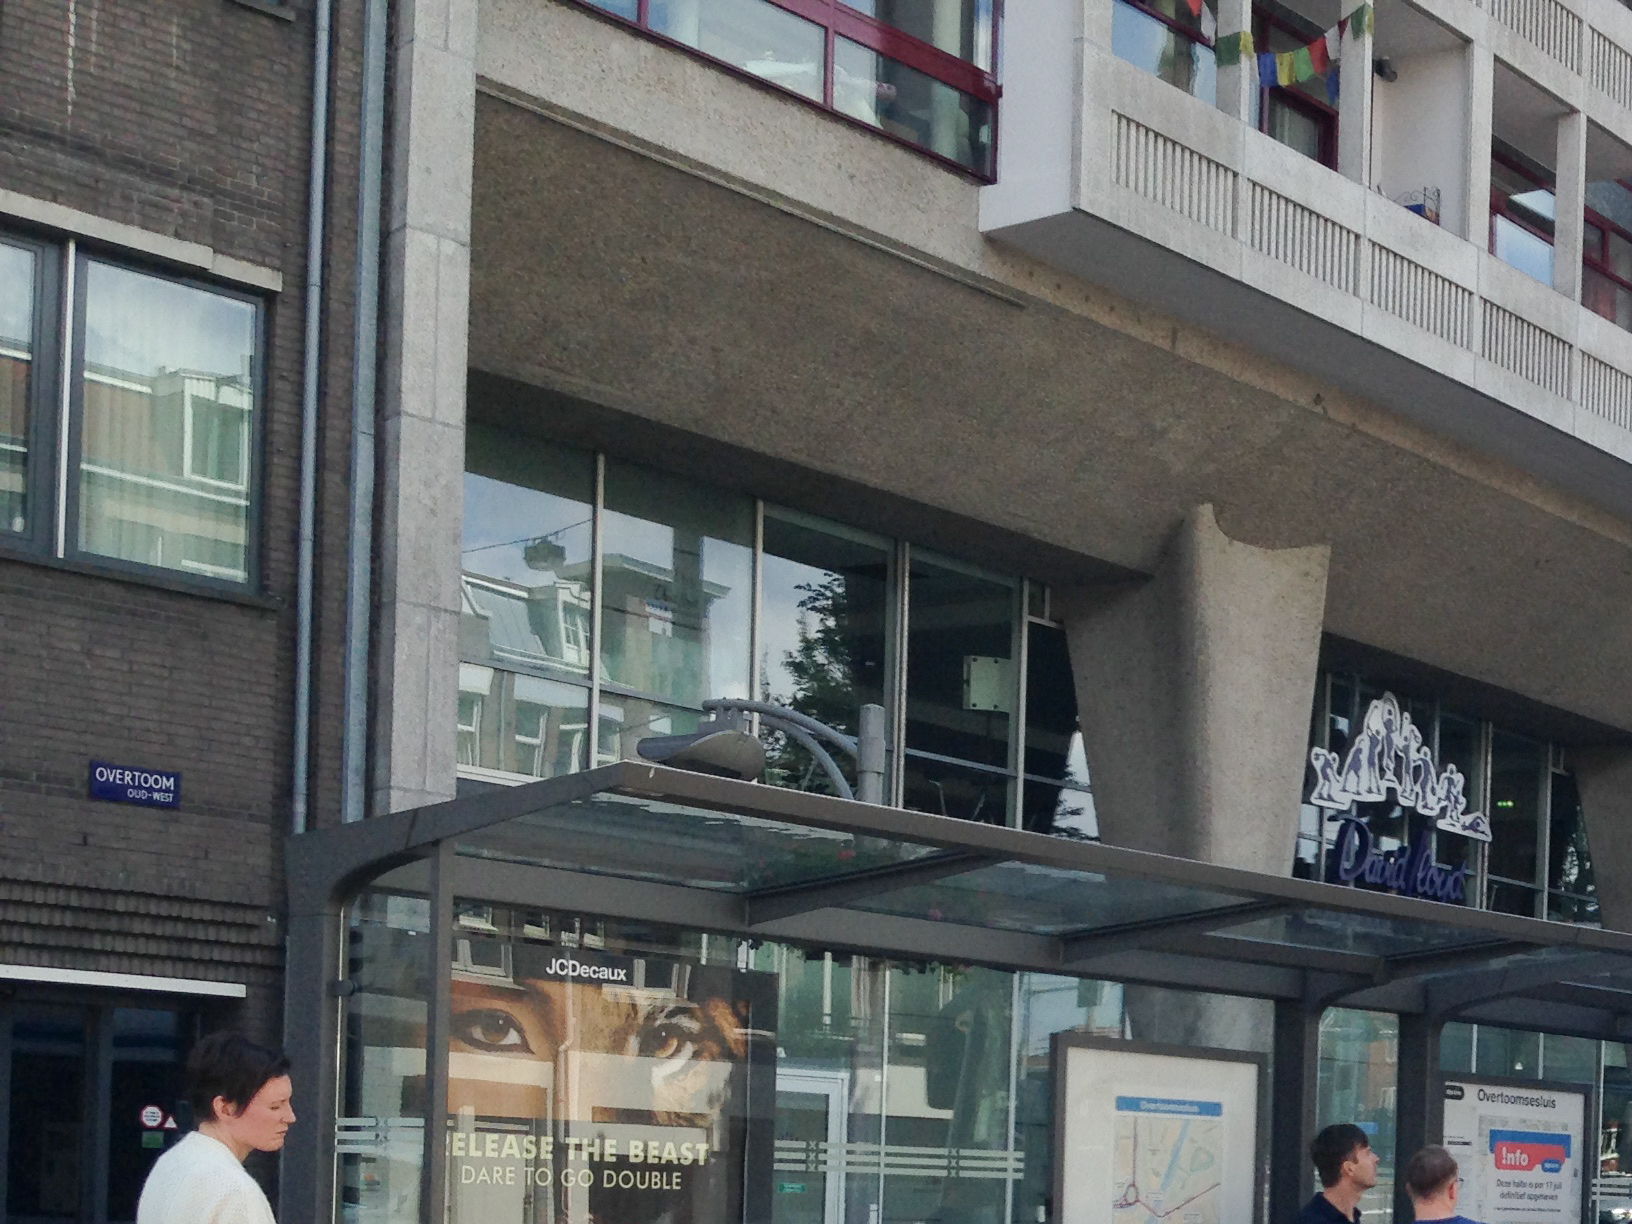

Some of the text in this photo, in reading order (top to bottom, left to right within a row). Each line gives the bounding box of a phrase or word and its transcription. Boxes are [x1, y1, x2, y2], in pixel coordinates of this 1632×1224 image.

[95, 766, 175, 791] OVERTOOM
[127, 788, 174, 803] OUD-WEST
[546, 958, 627, 982] JCDecaux
[1477, 1088, 1557, 1109] Overtoomsesluis
[446, 1131, 709, 1166] ELEASE THE BEAST
[461, 1165, 682, 1190] DARE TO GO DOUBLE
